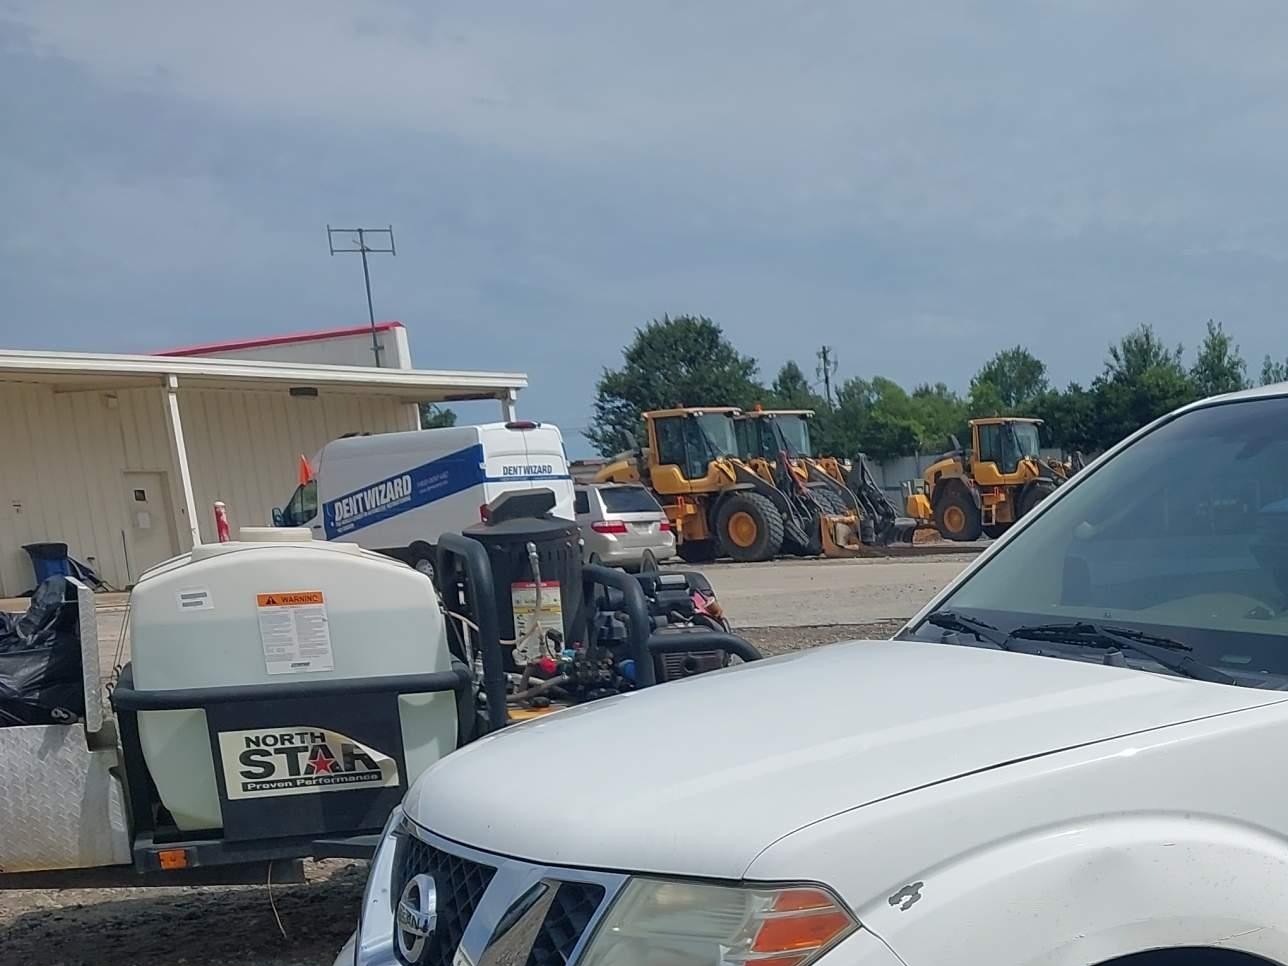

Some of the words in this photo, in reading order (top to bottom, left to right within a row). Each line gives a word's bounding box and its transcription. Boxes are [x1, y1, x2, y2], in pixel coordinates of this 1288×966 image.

[281, 594, 319, 603] WARNING
[245, 732, 326, 748] NORTH
[238, 743, 381, 780] STAR
[247, 780, 293, 791] Proven
[296, 773, 379, 786] Performance
